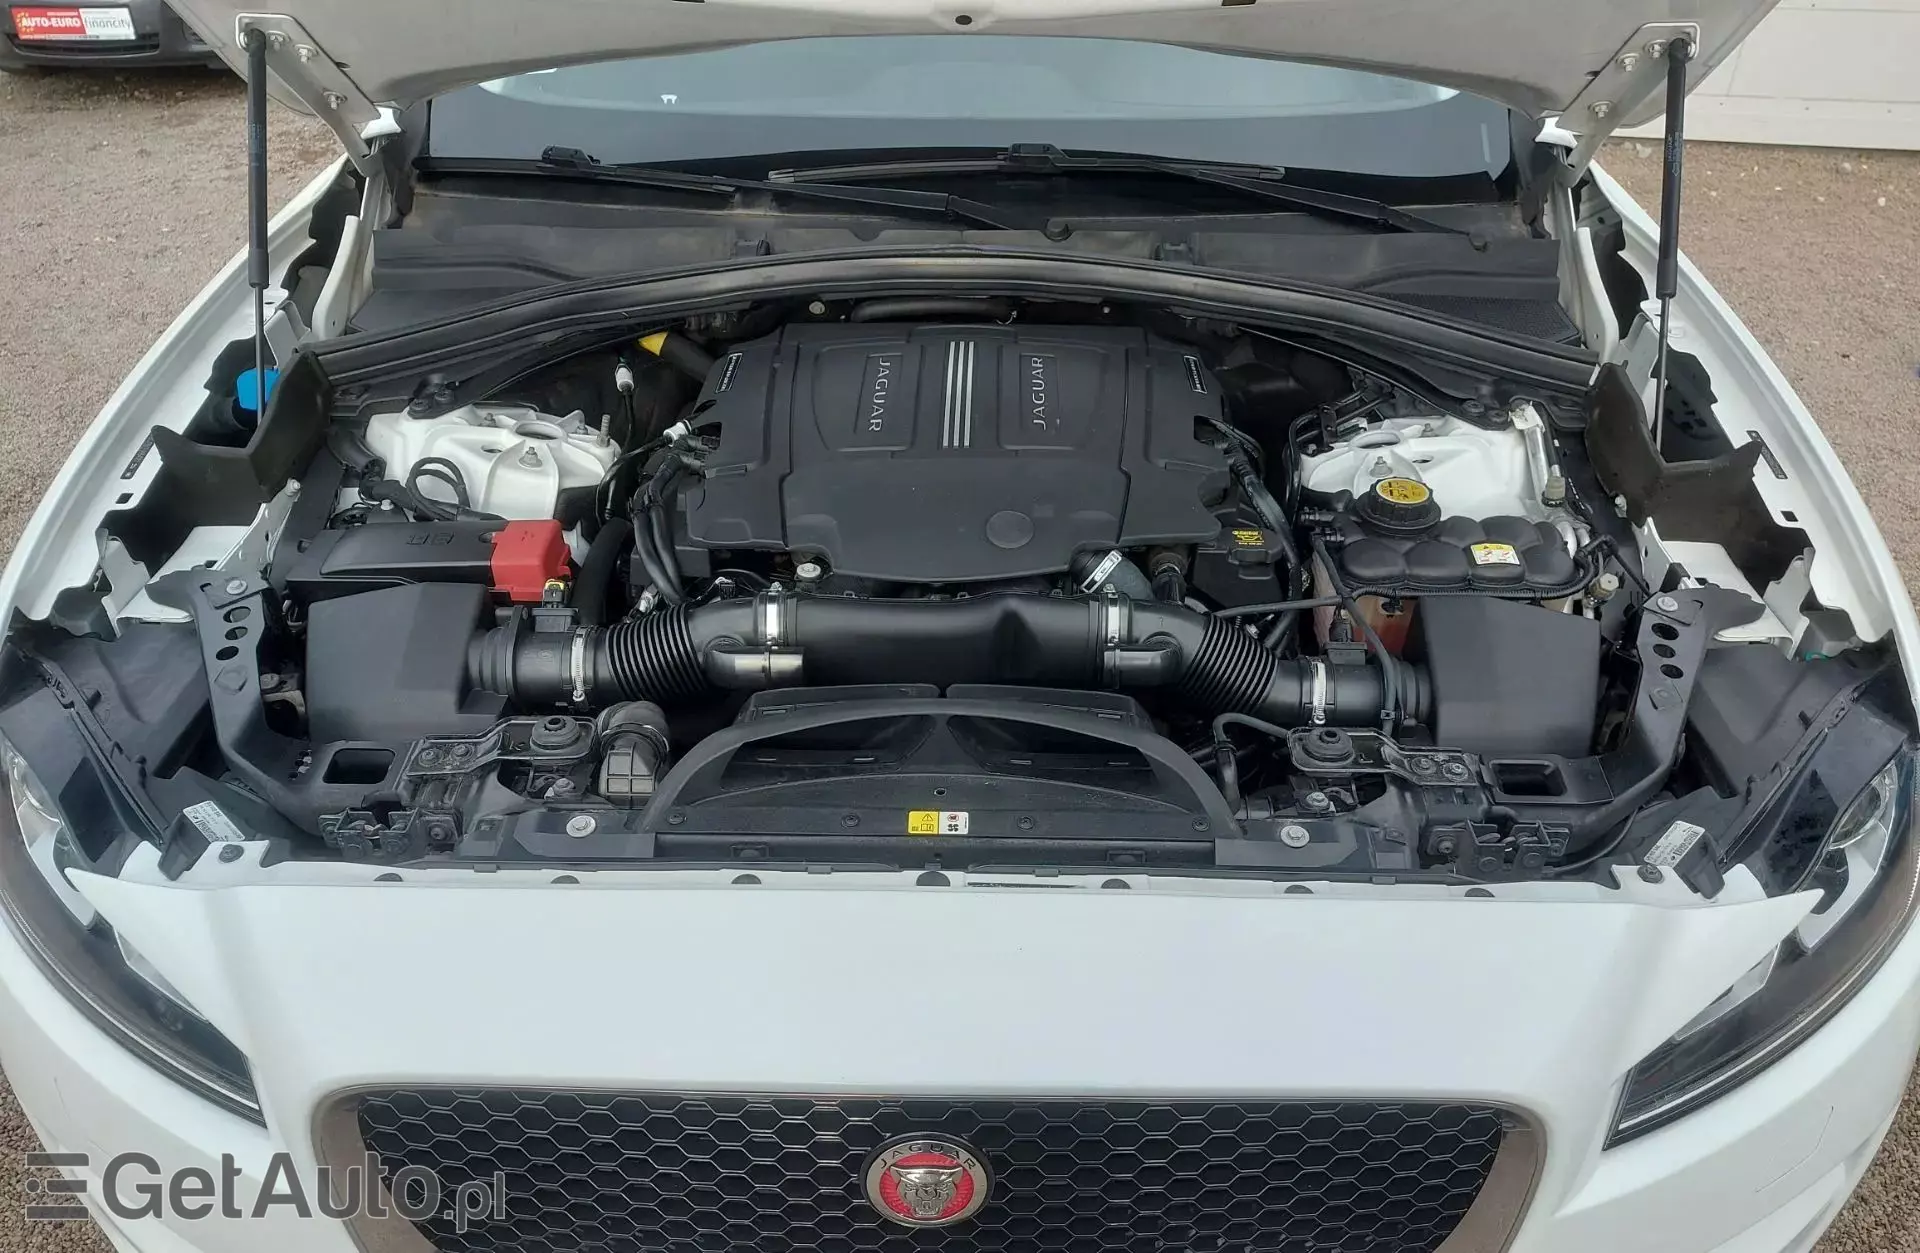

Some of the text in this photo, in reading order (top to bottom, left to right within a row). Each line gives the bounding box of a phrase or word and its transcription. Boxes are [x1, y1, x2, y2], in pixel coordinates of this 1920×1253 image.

[22, 16, 81, 28] AUTO-EURO
[868, 357, 891, 432] JAGUAR
[1031, 357, 1047, 430] JAGUAR
[880, 1143, 977, 1170] JAGUAR
